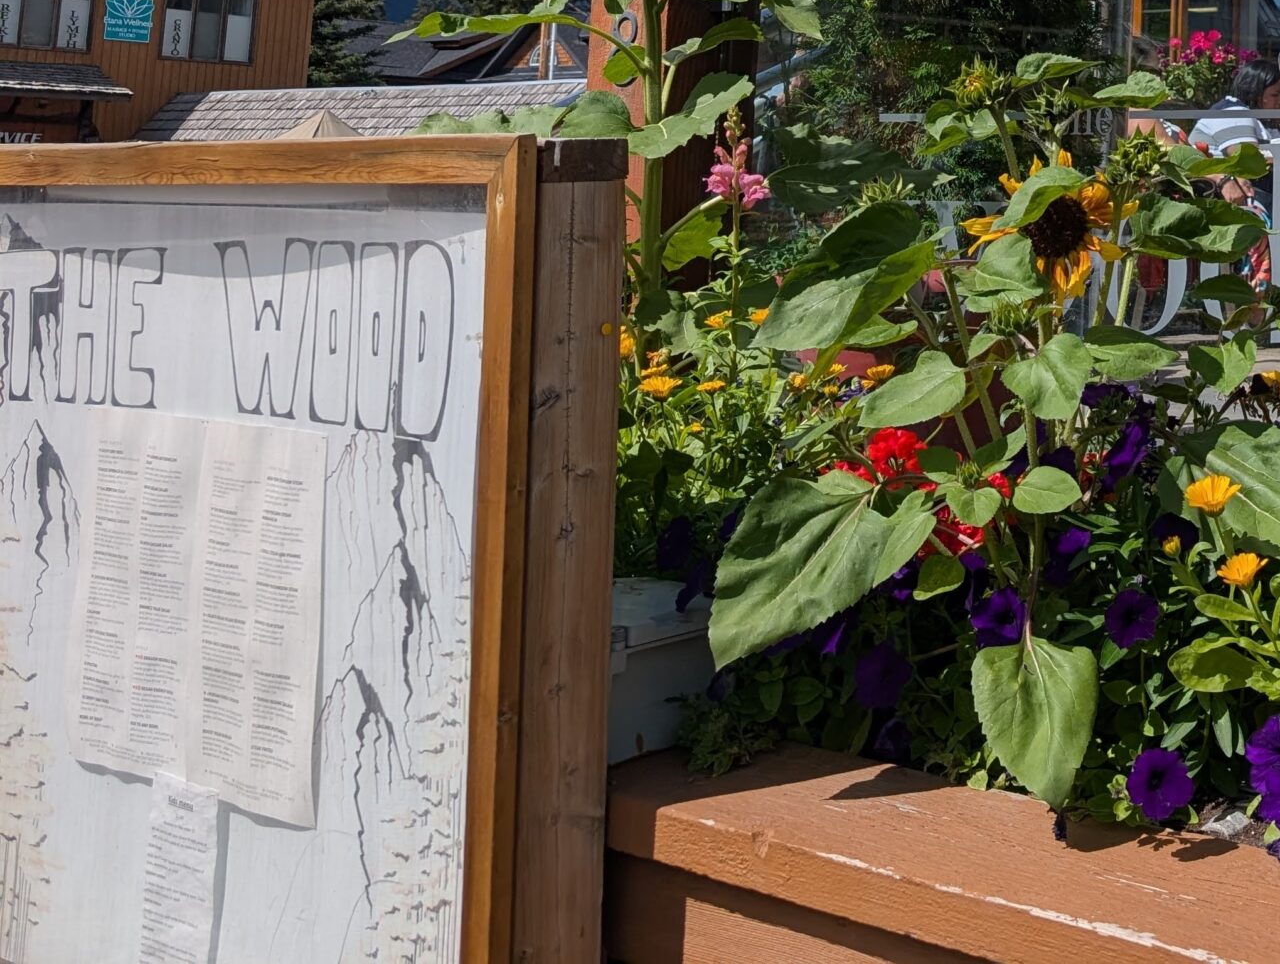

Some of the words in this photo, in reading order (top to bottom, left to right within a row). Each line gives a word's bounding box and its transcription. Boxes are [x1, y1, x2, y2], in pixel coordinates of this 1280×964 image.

[0, 3, 10, 43] REIKI
[66, 9, 80, 49] LYMPH
[124, 18, 153, 27] Wellness
[171, 19, 181, 56] CRANIO
[0, 247, 168, 409] THE
[213, 237, 455, 442] WOOD
